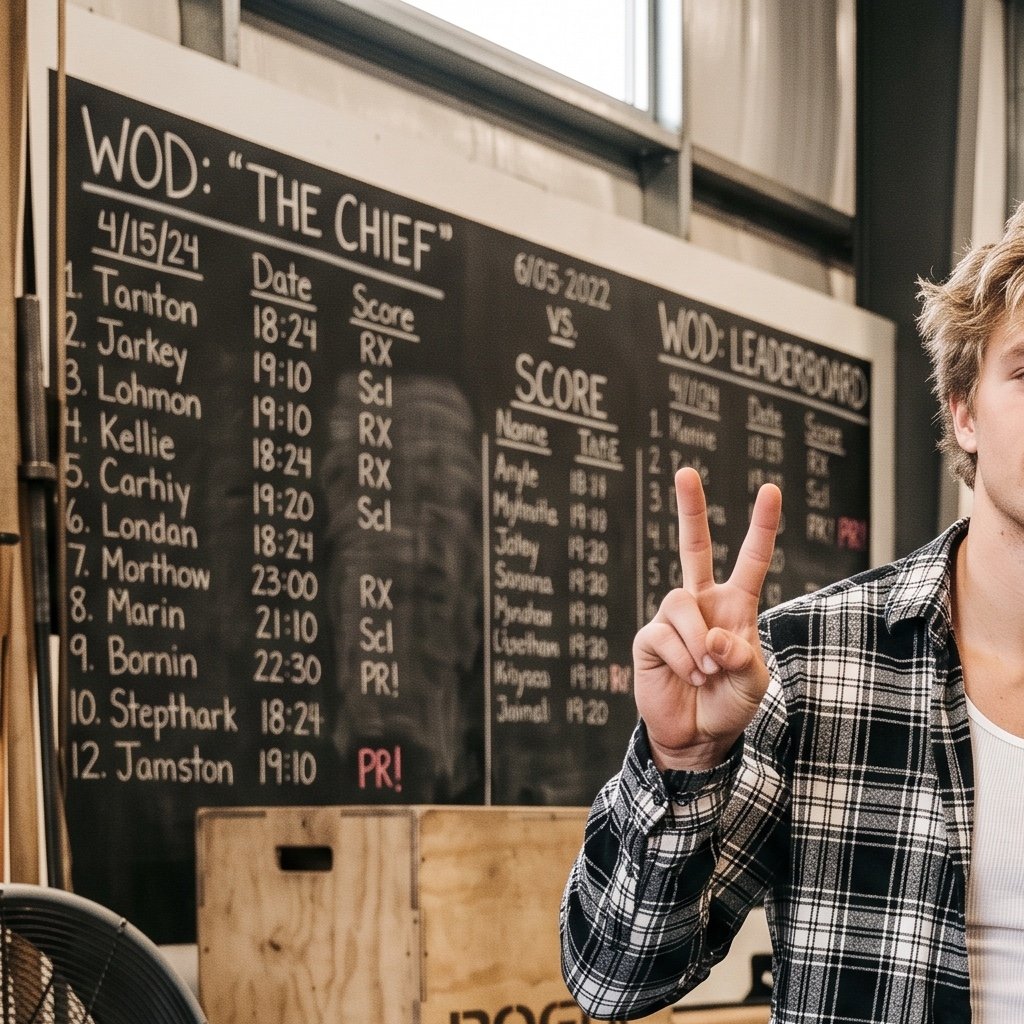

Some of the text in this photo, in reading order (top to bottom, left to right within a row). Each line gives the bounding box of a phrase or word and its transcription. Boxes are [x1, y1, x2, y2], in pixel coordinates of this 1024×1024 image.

[82, 104, 211, 200] WOD:
[98, 209, 199, 270] 4/15/24
[252, 252, 415, 333] Date Score
[65, 311, 87, 348] 2.
[97, 316, 188, 385] Jarkey
[253, 350, 312, 393] 19:10
[253, 304, 317, 352] 18:24
[360, 331, 393, 368] RX
[658, 301, 869, 411] WOD: LEADERBOARD
[65, 358, 88, 397] 3.
[253, 395, 312, 437] 19:10
[358, 411, 393, 450] RX
[515, 353, 608, 420] SCORE
[100, 411, 176, 461] Kellie
[253, 437, 312, 479] 18:24
[358, 452, 392, 491] RX
[65, 452, 90, 488] 5.
[253, 482, 314, 522] 19:20
[65, 497, 314, 563] 6. Londan 18:24
[67, 542, 394, 611] 7. Morthow 23:00 RX
[69, 585, 94, 623] 8.
[107, 587, 185, 630] Marin
[256, 605, 318, 644] 21:10
[69, 633, 399, 698] 9. Bornin 22:30 PR!
[70, 687, 322, 742] 10. Stepthark 18:24
[72, 740, 403, 793] 12. Jamston 19:10 PR!
